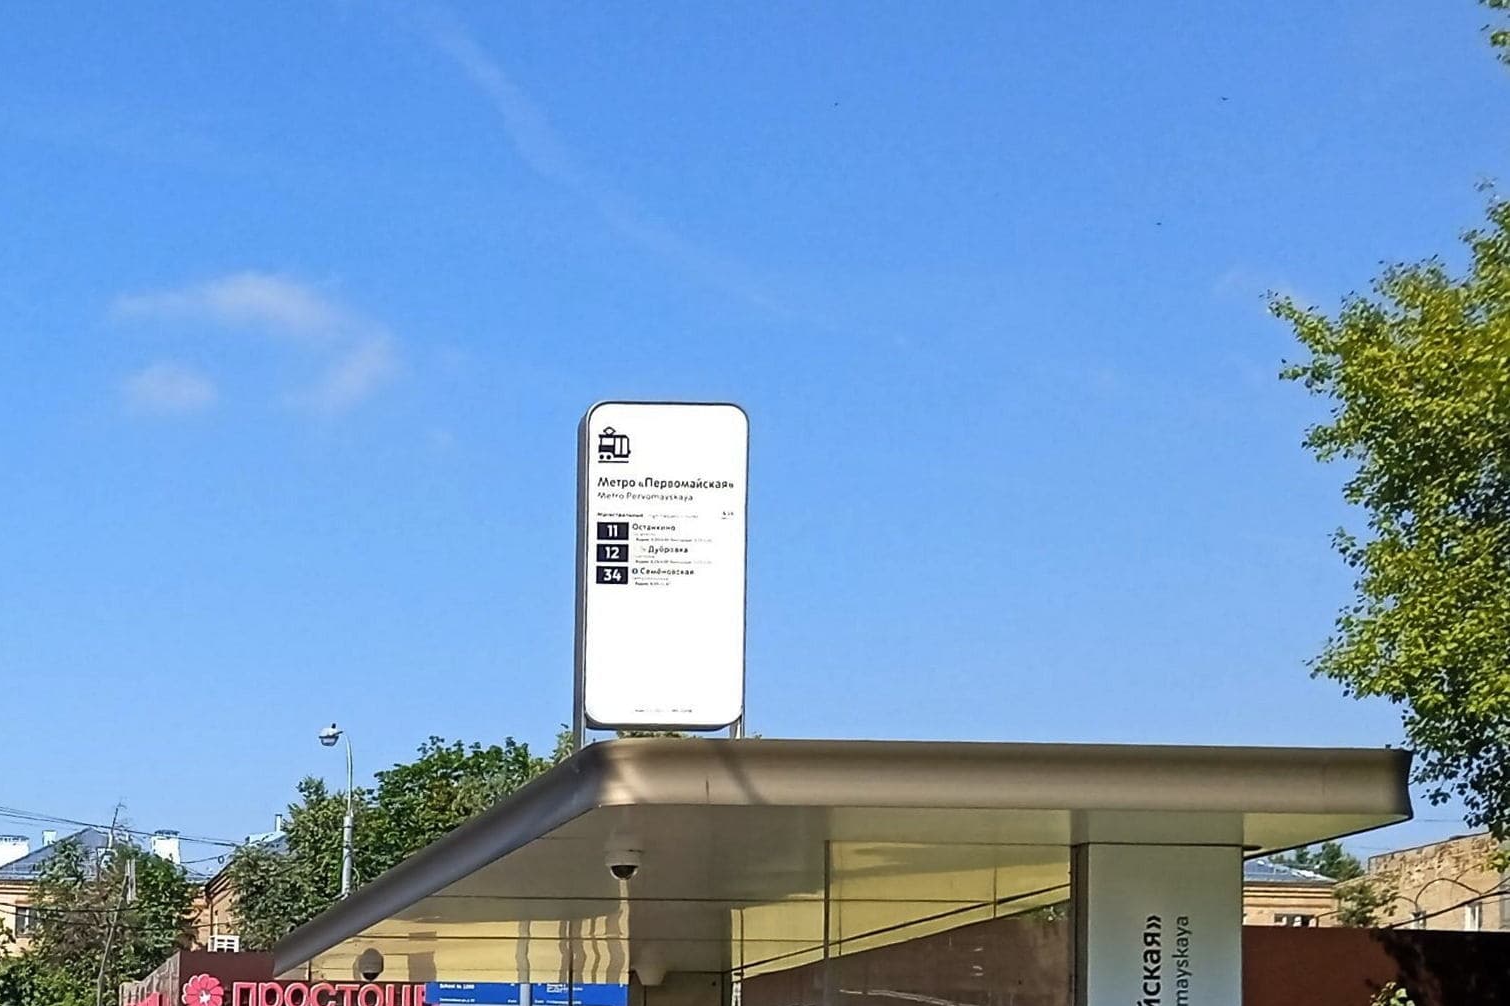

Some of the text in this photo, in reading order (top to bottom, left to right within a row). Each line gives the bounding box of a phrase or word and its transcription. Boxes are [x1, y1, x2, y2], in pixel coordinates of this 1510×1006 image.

[597, 477, 636, 489] Метро
[607, 524, 618, 537] 11
[605, 547, 620, 559] 12
[603, 568, 622, 581] 34
